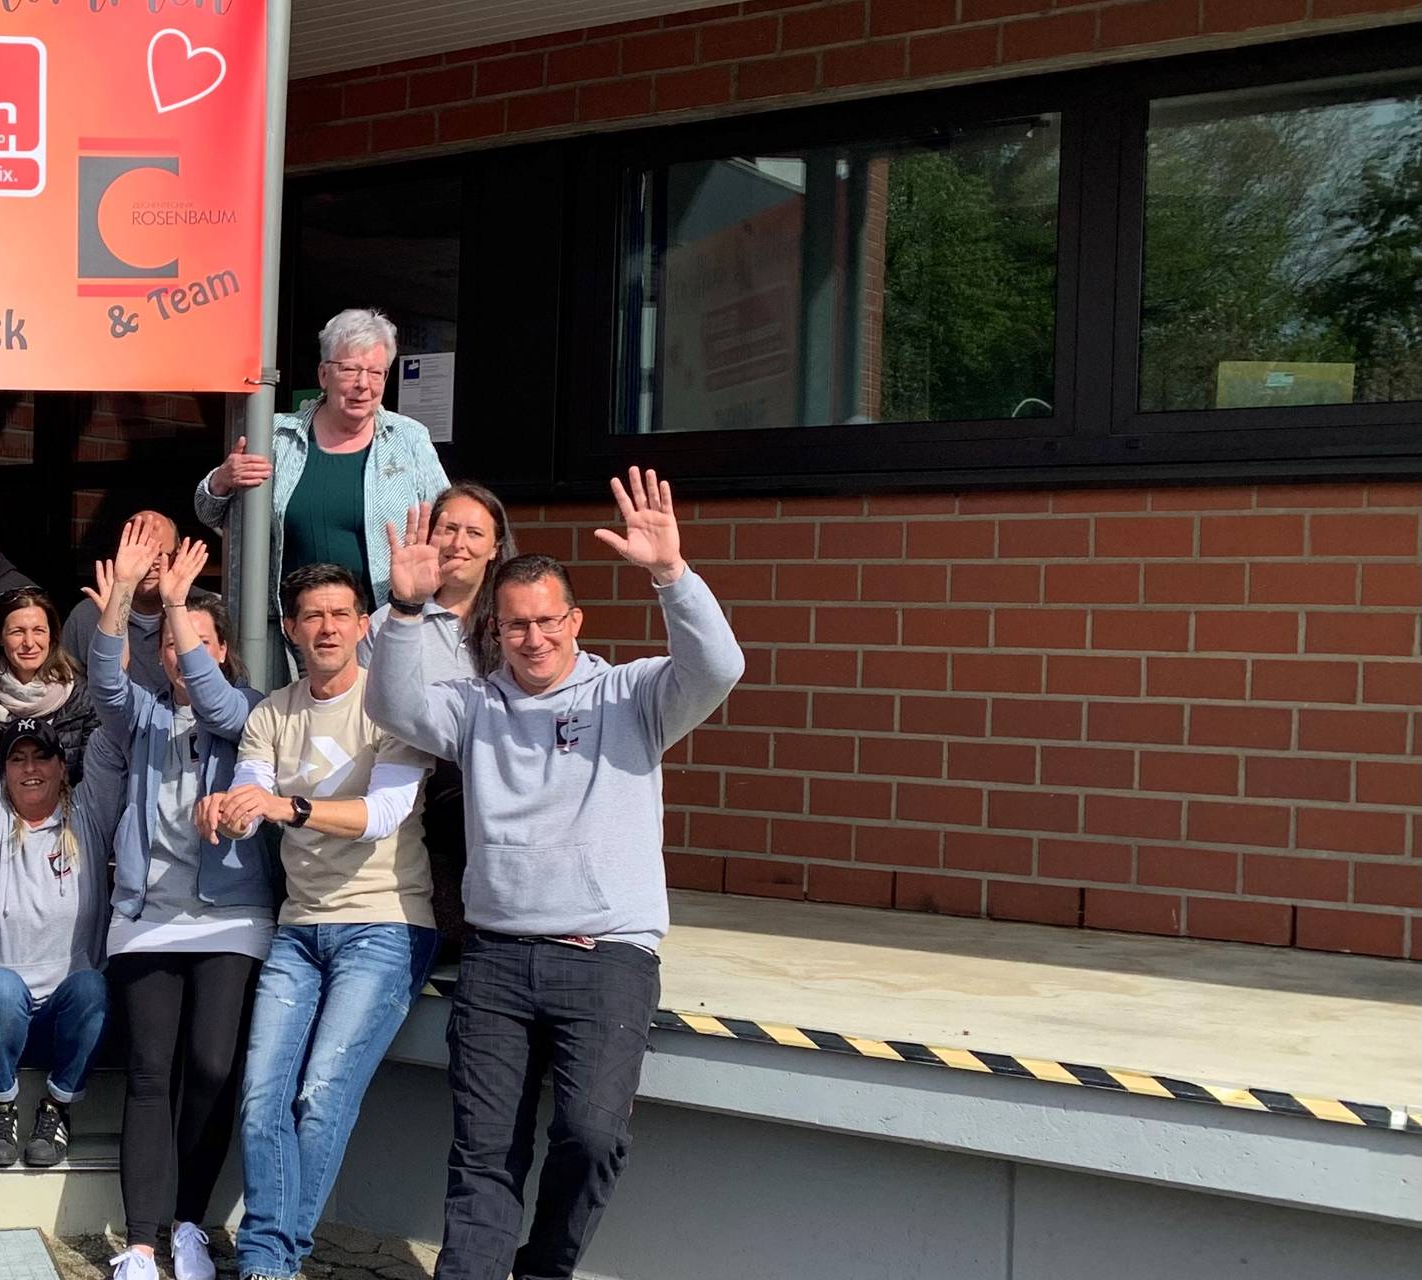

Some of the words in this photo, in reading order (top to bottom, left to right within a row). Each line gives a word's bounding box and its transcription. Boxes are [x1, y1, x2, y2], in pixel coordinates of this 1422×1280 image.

[132, 210, 237, 226] ROSENBAUM
[108, 305, 139, 338] &
[147, 270, 240, 320] Team
